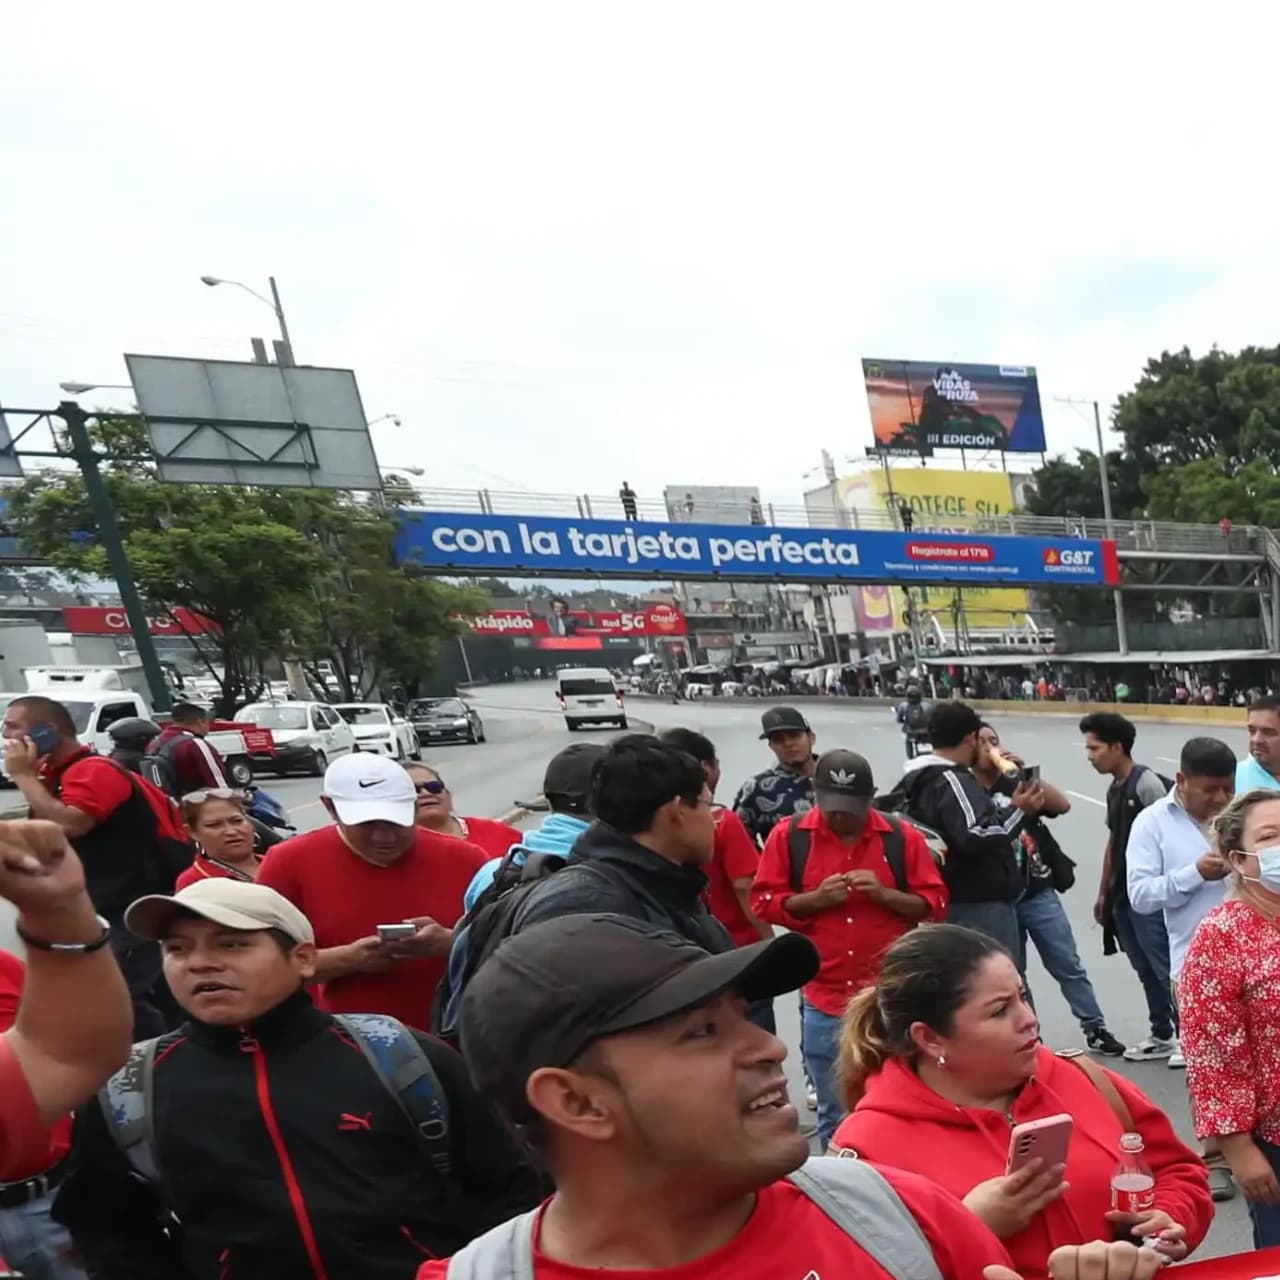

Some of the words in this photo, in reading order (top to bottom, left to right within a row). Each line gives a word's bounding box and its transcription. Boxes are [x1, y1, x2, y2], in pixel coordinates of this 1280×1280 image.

[942, 433, 995, 446] EDICIÓN
[431, 526, 511, 554] con
[518, 522, 561, 556] la
[566, 526, 701, 564] tarjeta
[708, 531, 860, 566] perfecta
[1060, 550, 1095, 565] G&T
[621, 613, 645, 631] 5G
